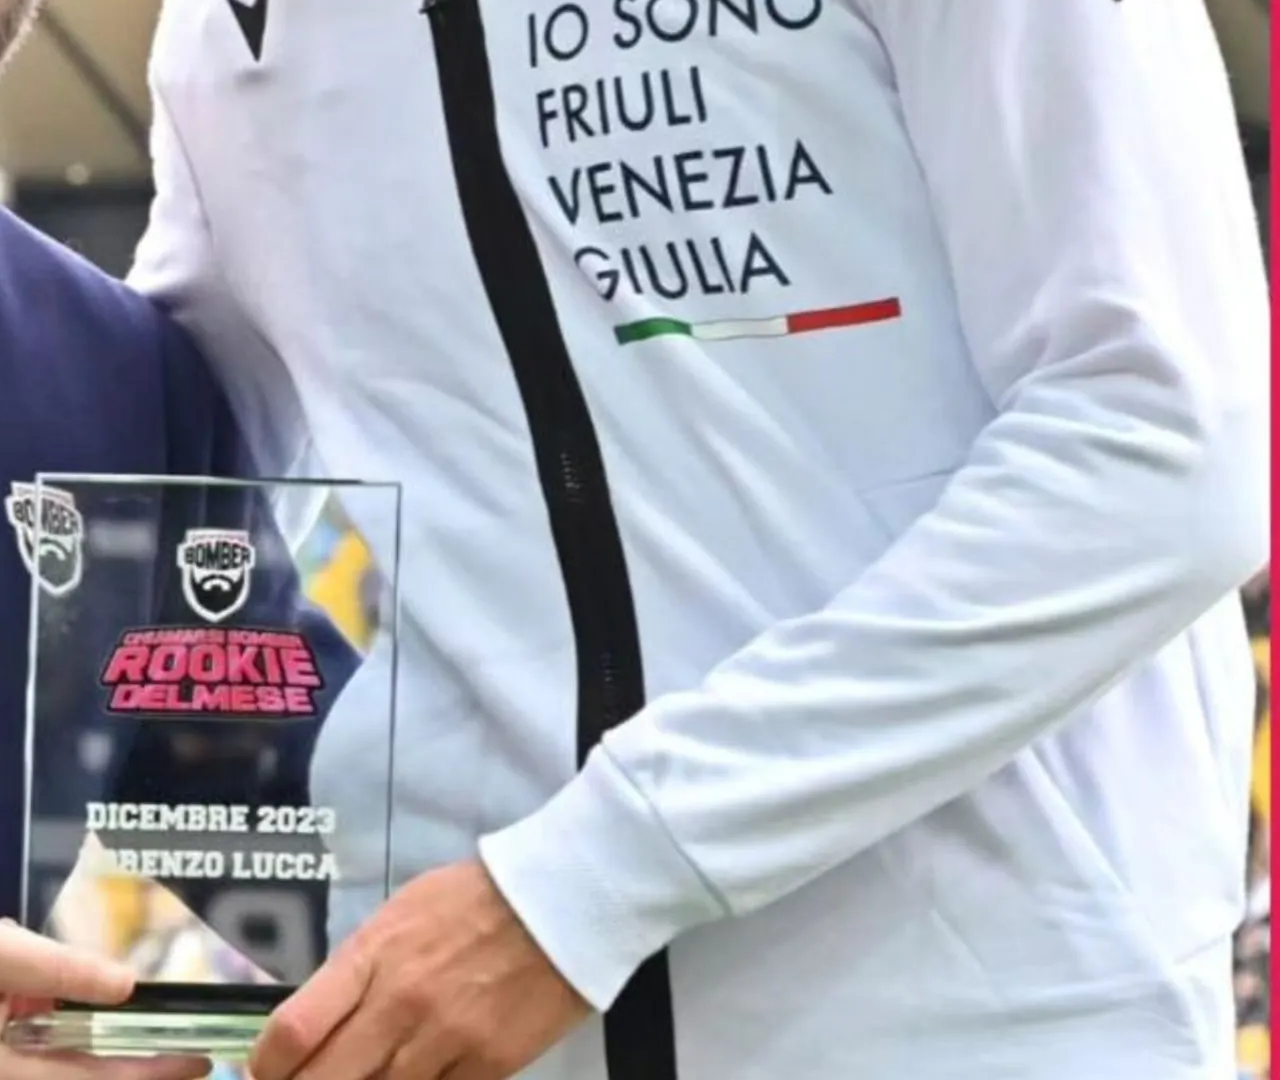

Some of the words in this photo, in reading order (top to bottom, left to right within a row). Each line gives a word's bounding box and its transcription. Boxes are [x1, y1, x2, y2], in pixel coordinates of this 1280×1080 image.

[528, 3, 589, 69] IO
[536, 66, 708, 148] FRIULI
[548, 138, 834, 227] VENEZIA
[574, 231, 792, 302] GIULIA
[184, 540, 251, 570] BOMBER
[102, 644, 321, 686] ROOKIE
[85, 802, 249, 832] DICEMBRE
[256, 806, 337, 834] 2023
[85, 849, 224, 878] RENZO
[232, 850, 341, 880] LUCCA
